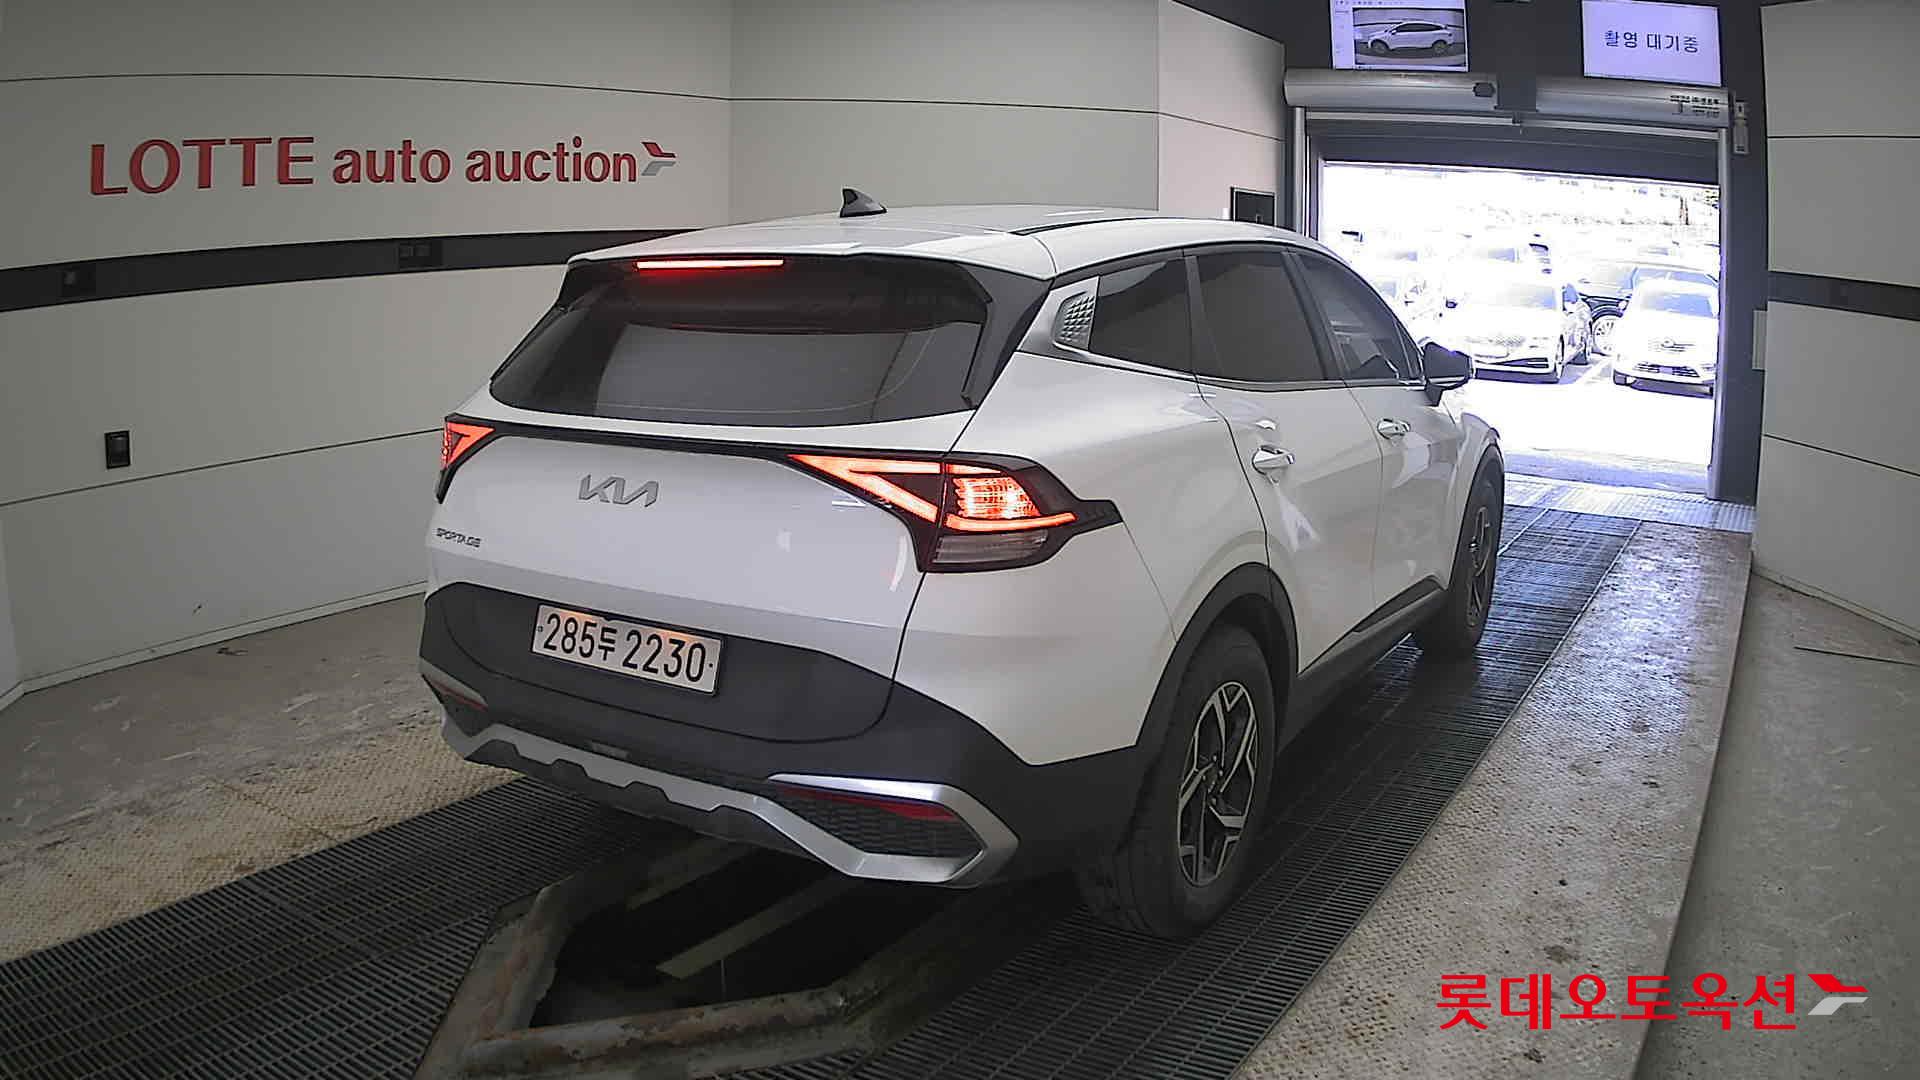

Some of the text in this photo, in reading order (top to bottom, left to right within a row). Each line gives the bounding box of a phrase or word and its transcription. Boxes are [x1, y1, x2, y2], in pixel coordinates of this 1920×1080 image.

[1604, 30, 1698, 53] 촬영 대기중
[90, 135, 638, 196] LOTTE auto auction
[577, 473, 659, 507] KIA
[436, 527, 482, 548] SPORTAGE
[543, 612, 706, 682] 285두 2230
